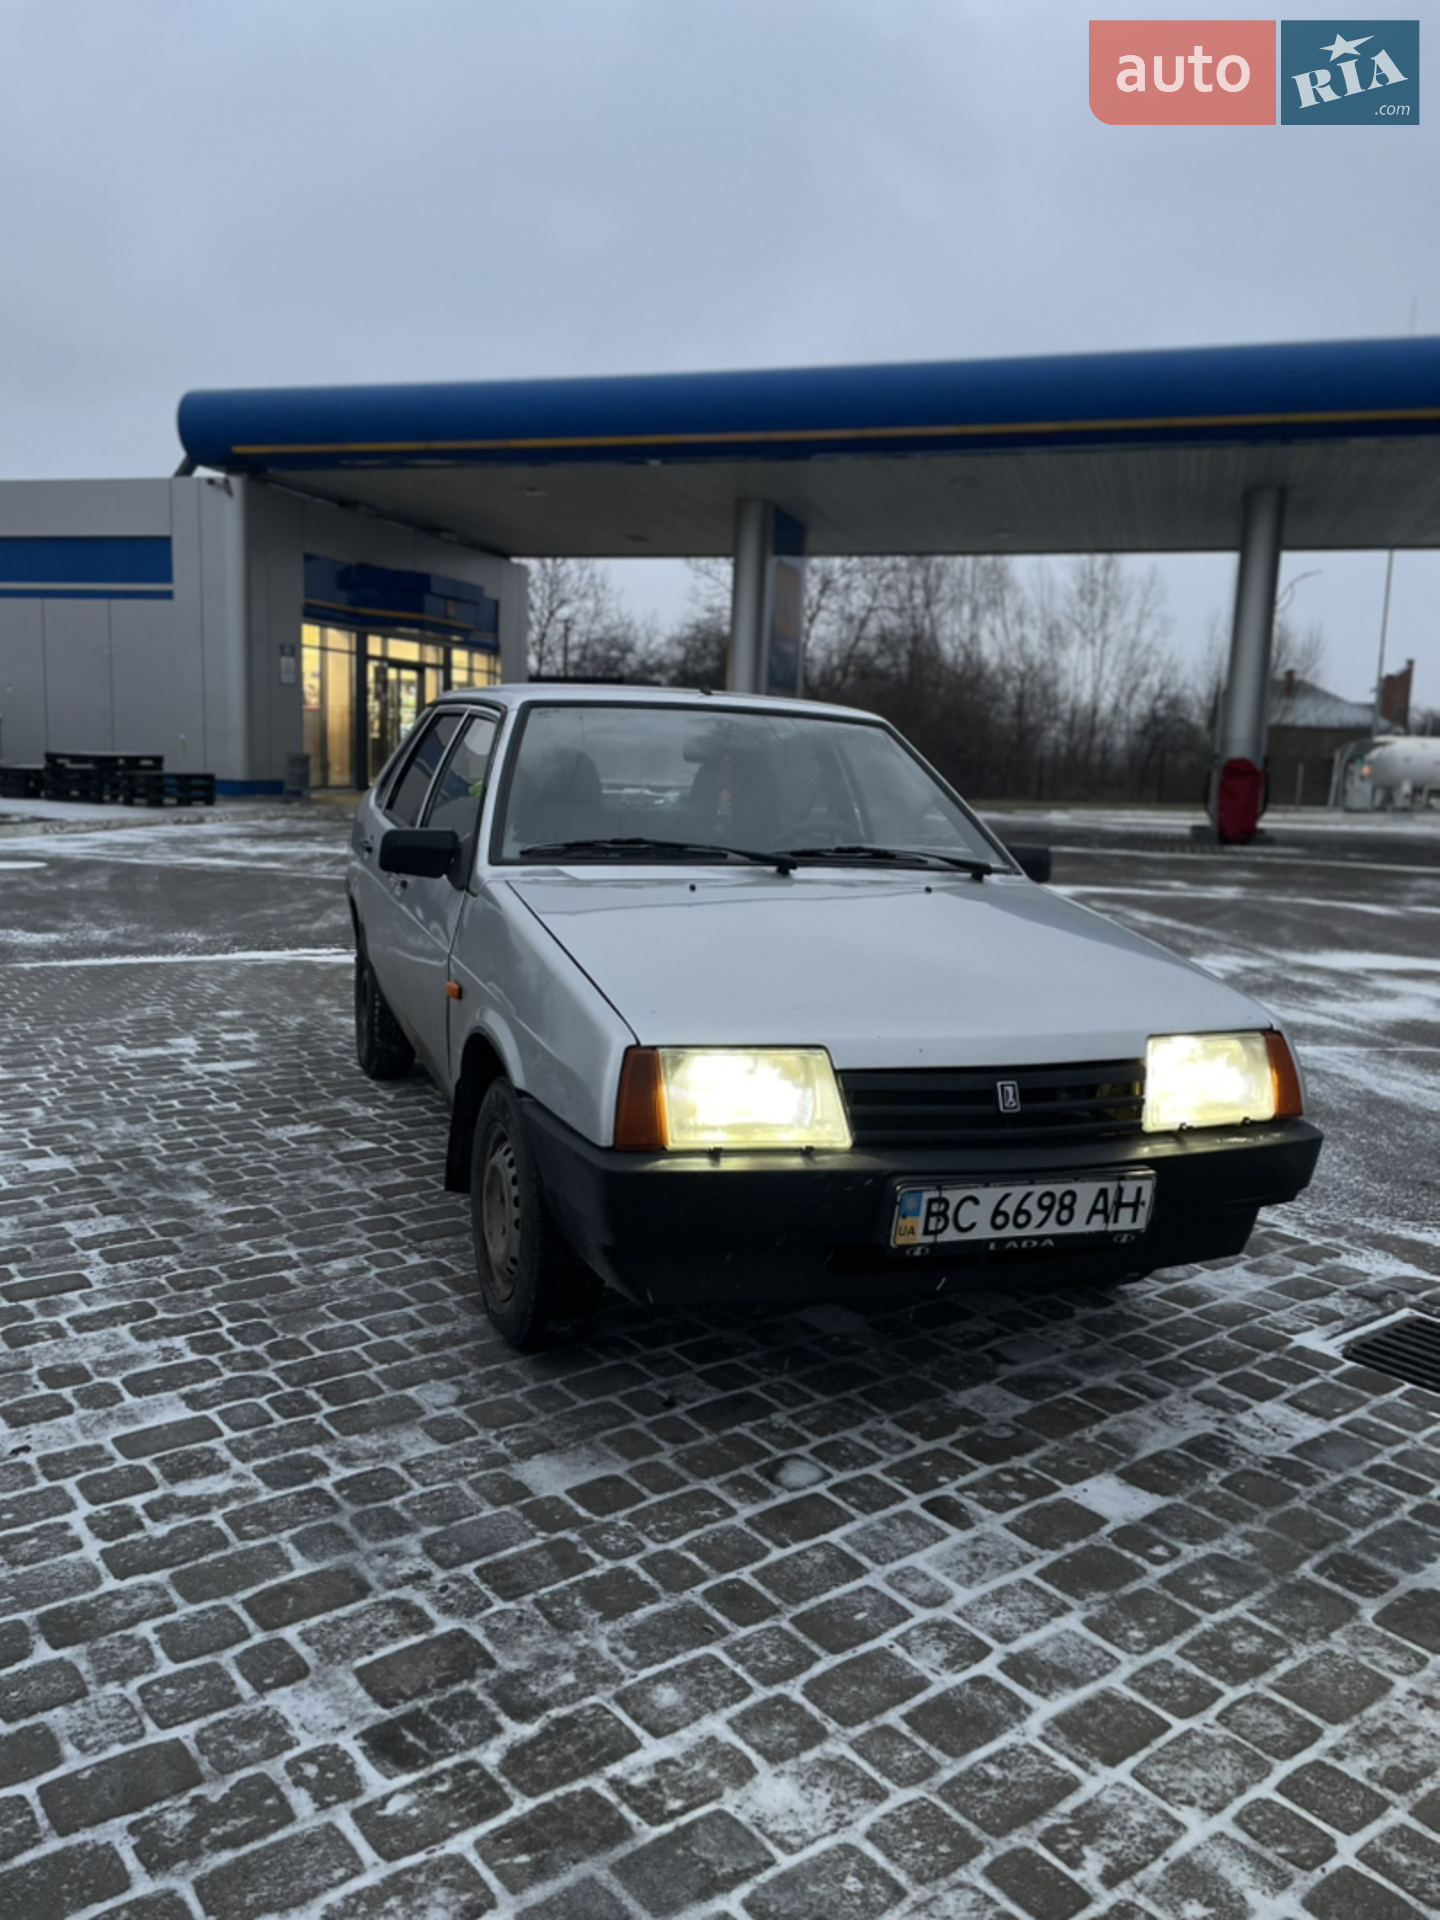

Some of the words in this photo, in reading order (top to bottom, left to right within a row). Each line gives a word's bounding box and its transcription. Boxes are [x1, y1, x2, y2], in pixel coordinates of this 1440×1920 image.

[922, 1194, 981, 1237] BC
[989, 1189, 1078, 1232] 6698
[1085, 1185, 1145, 1226] AH
[898, 1225, 916, 1237] UA
[989, 1239, 1055, 1251] LADA
